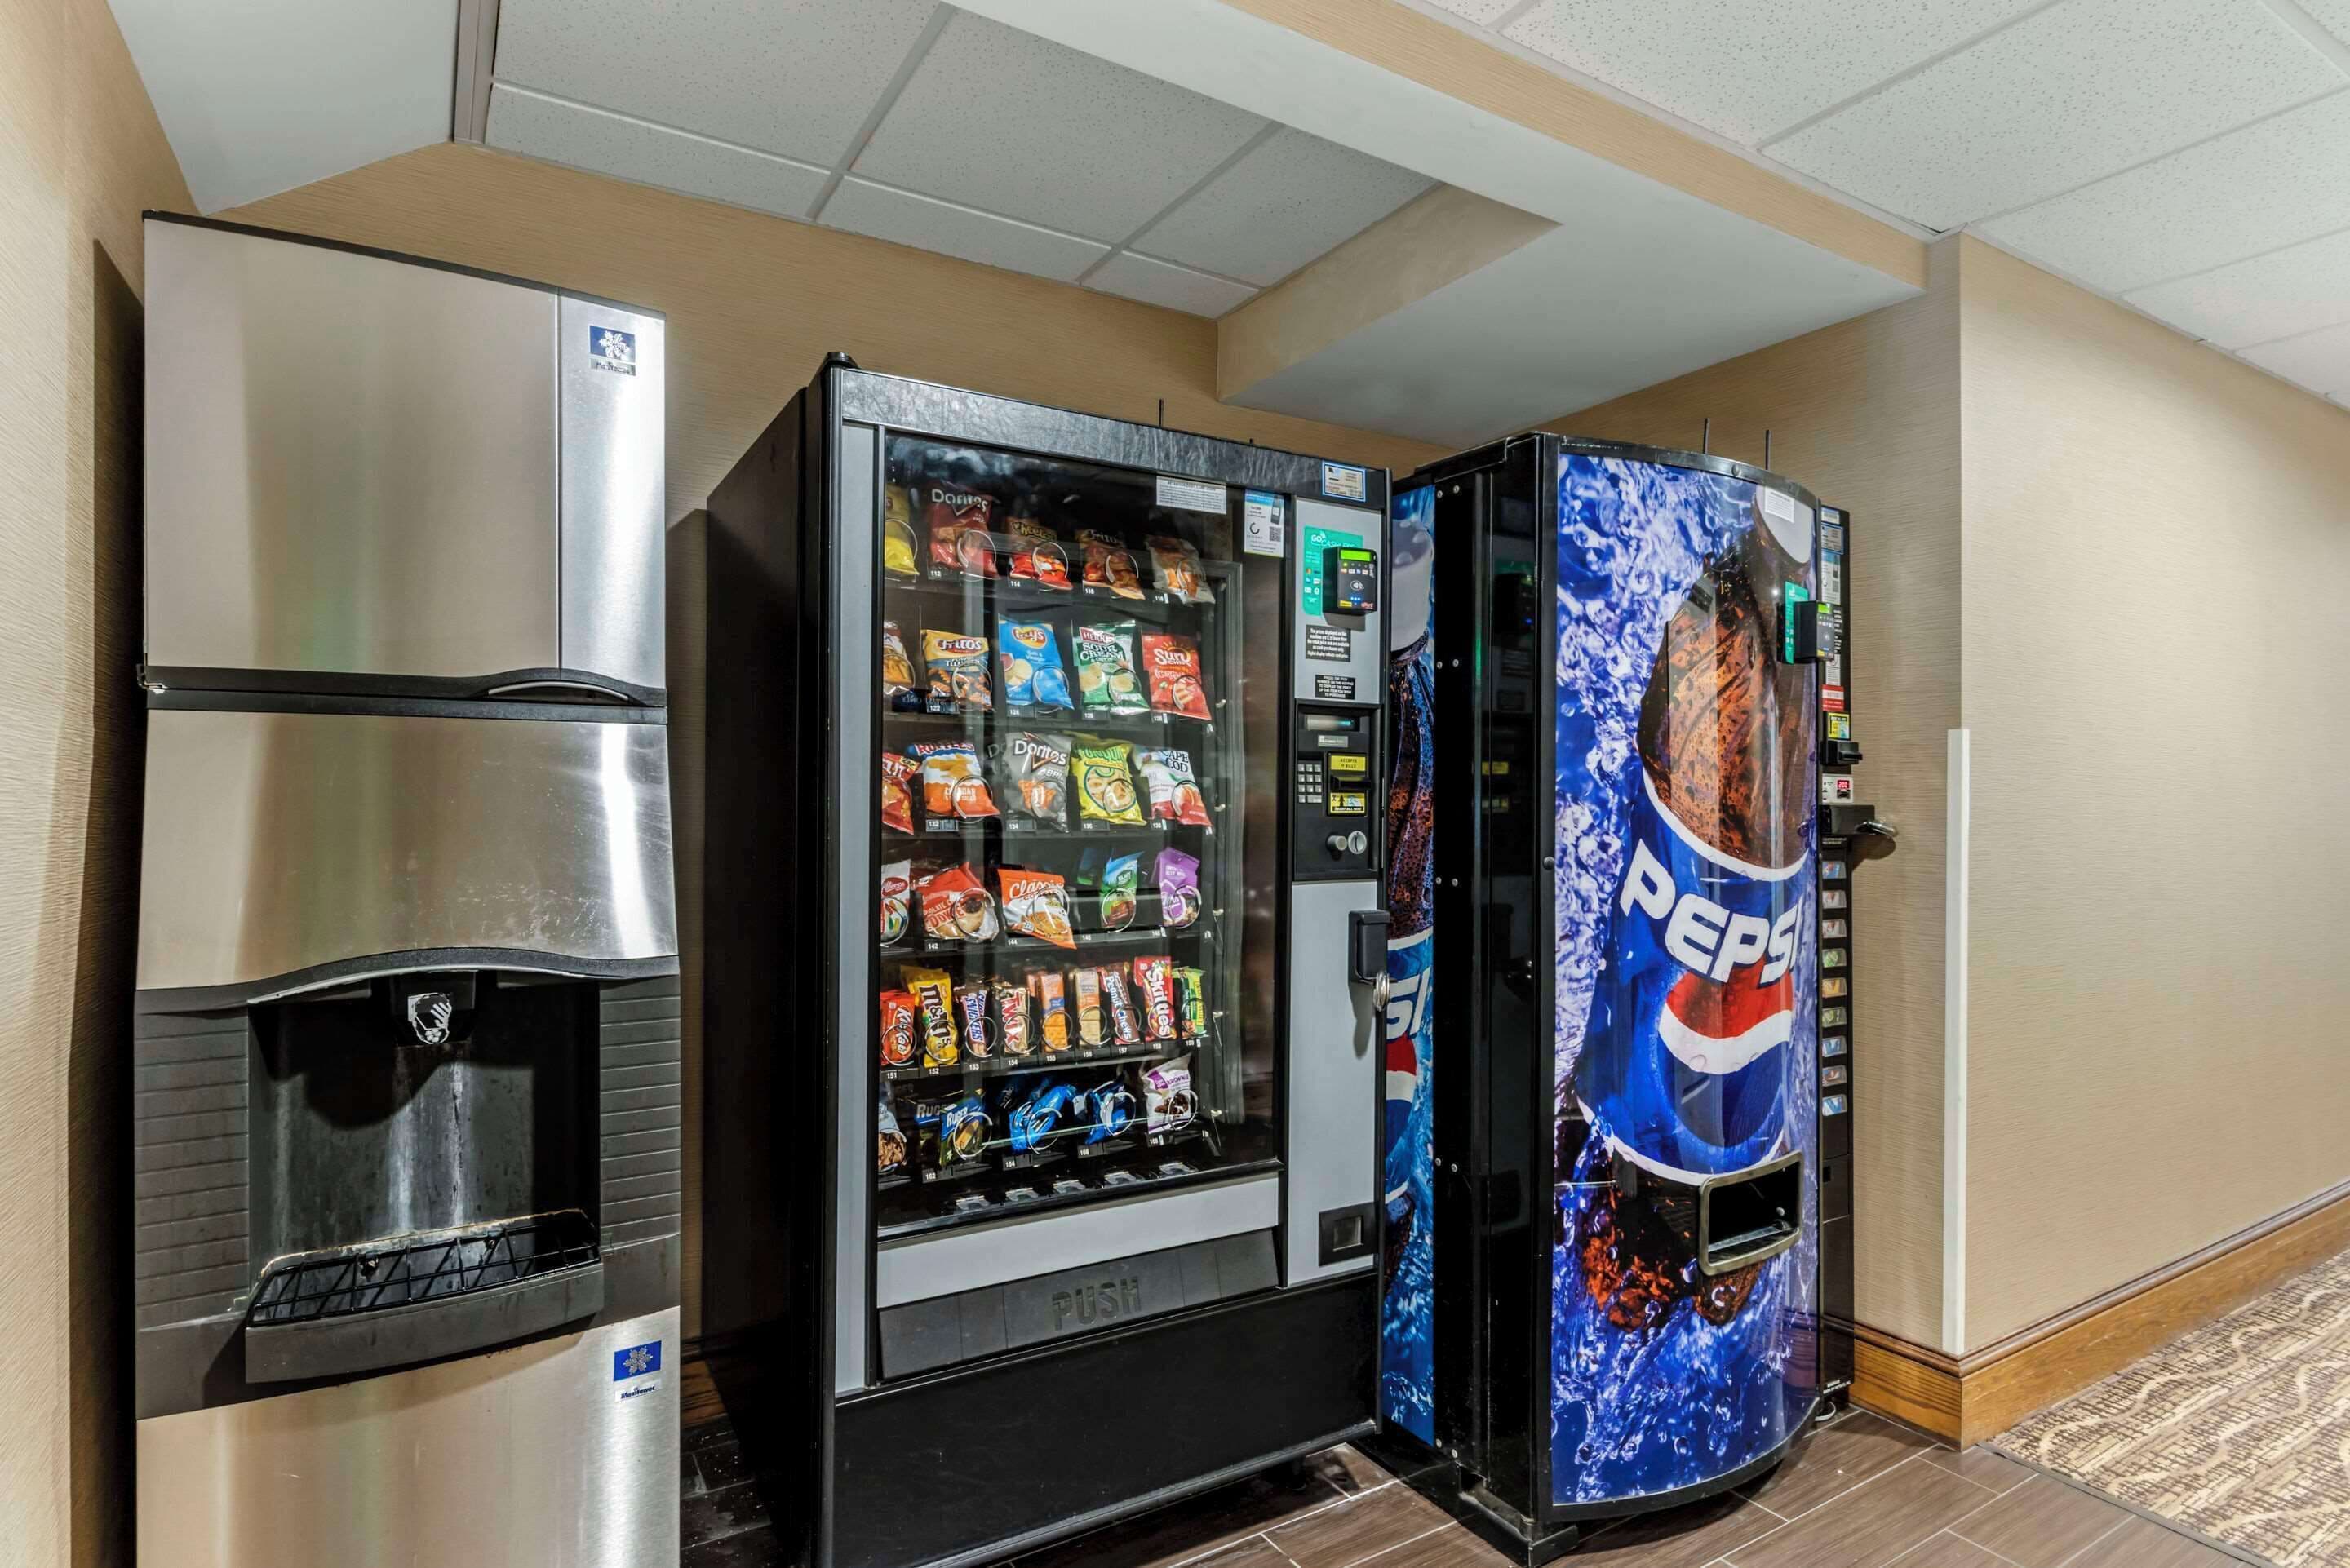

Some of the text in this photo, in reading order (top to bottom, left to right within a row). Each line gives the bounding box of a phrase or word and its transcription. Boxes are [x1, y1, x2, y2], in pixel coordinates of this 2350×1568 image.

[931, 489, 989, 512] Doritos
[936, 638, 982, 650] Fritos
[1015, 627, 1044, 641] Lay's
[1080, 650, 1124, 662] CREAM
[1082, 642, 1118, 653] SOUR
[1014, 740, 1067, 766] Doritos
[1165, 757, 1189, 773] COD
[1619, 838, 1803, 985] PEPSI
[1107, 976, 1124, 1008] Peanut
[1000, 991, 1021, 1044] TWIX
[1052, 1276, 1142, 1331] PUSH
